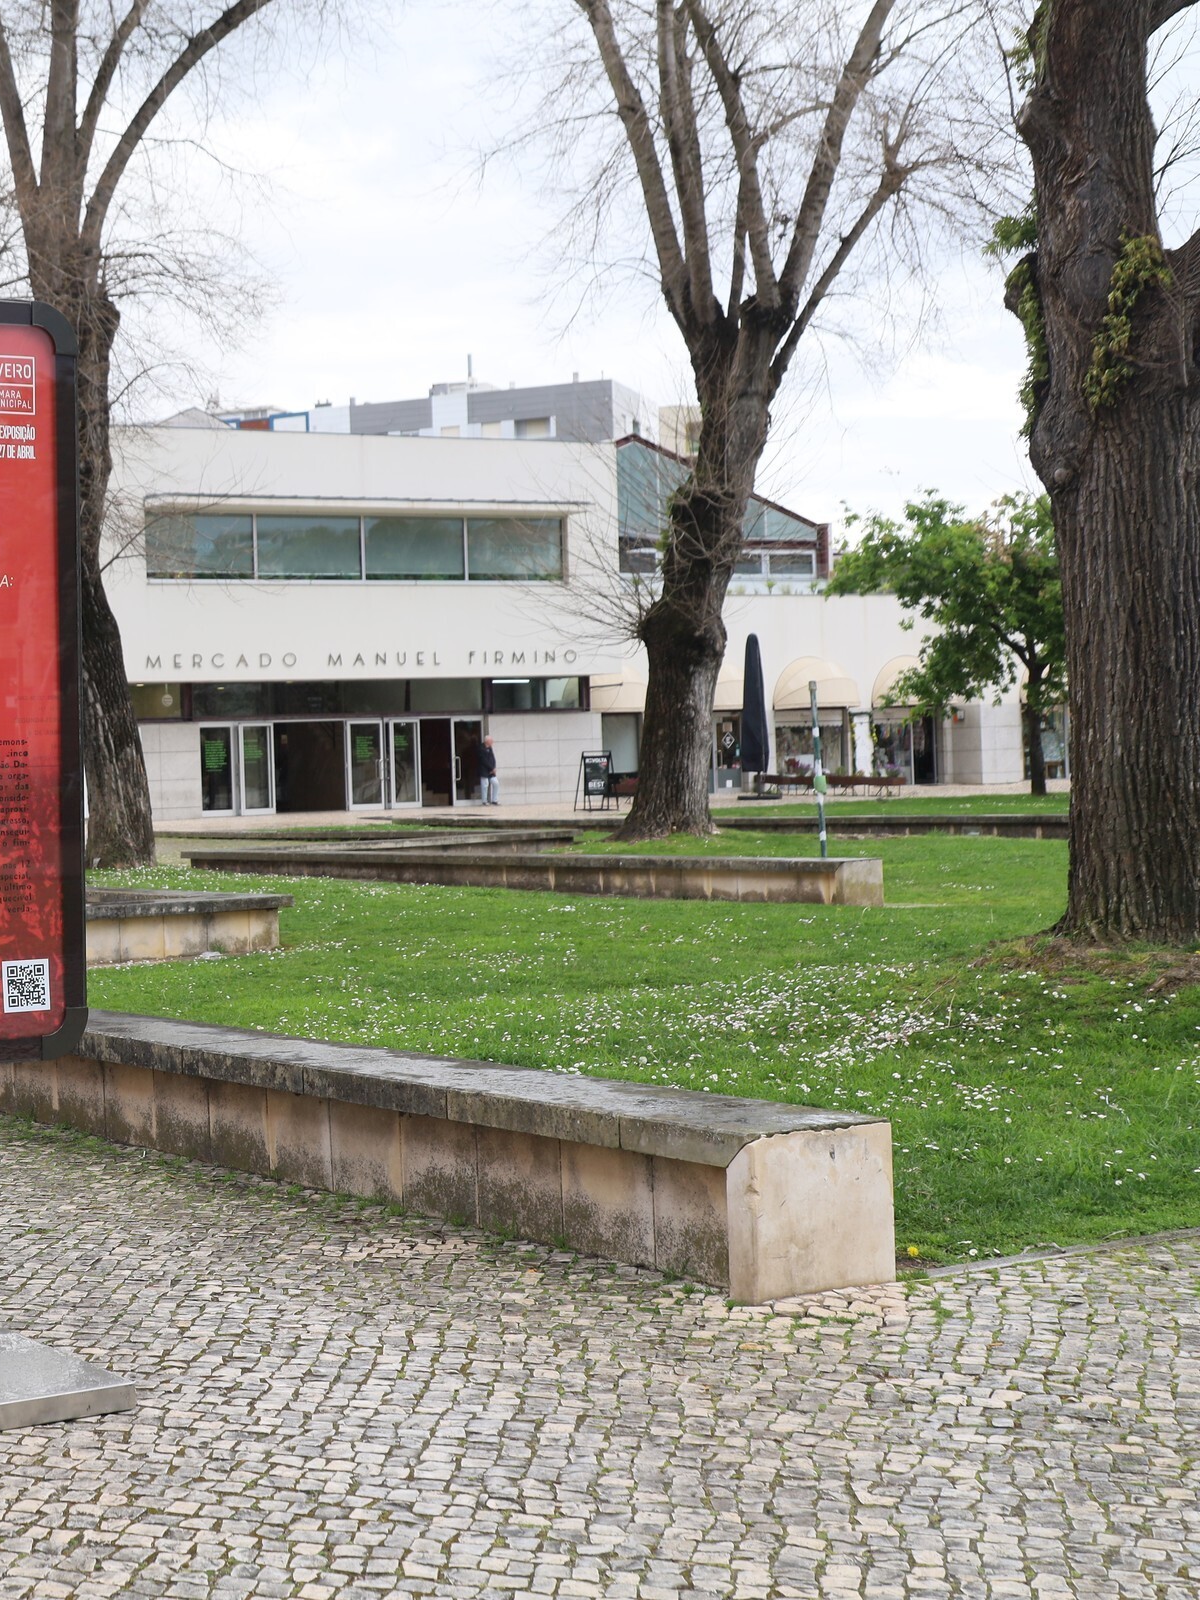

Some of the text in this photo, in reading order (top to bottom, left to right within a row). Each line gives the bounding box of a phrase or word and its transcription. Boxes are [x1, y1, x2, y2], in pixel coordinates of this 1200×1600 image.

[0, 424, 35, 442] EXPOSIÇÃO
[7, 445, 15, 459] DE
[17, 445, 36, 459] ABRIL
[146, 649, 578, 669] MERCADO MANUEL FIRMINO
